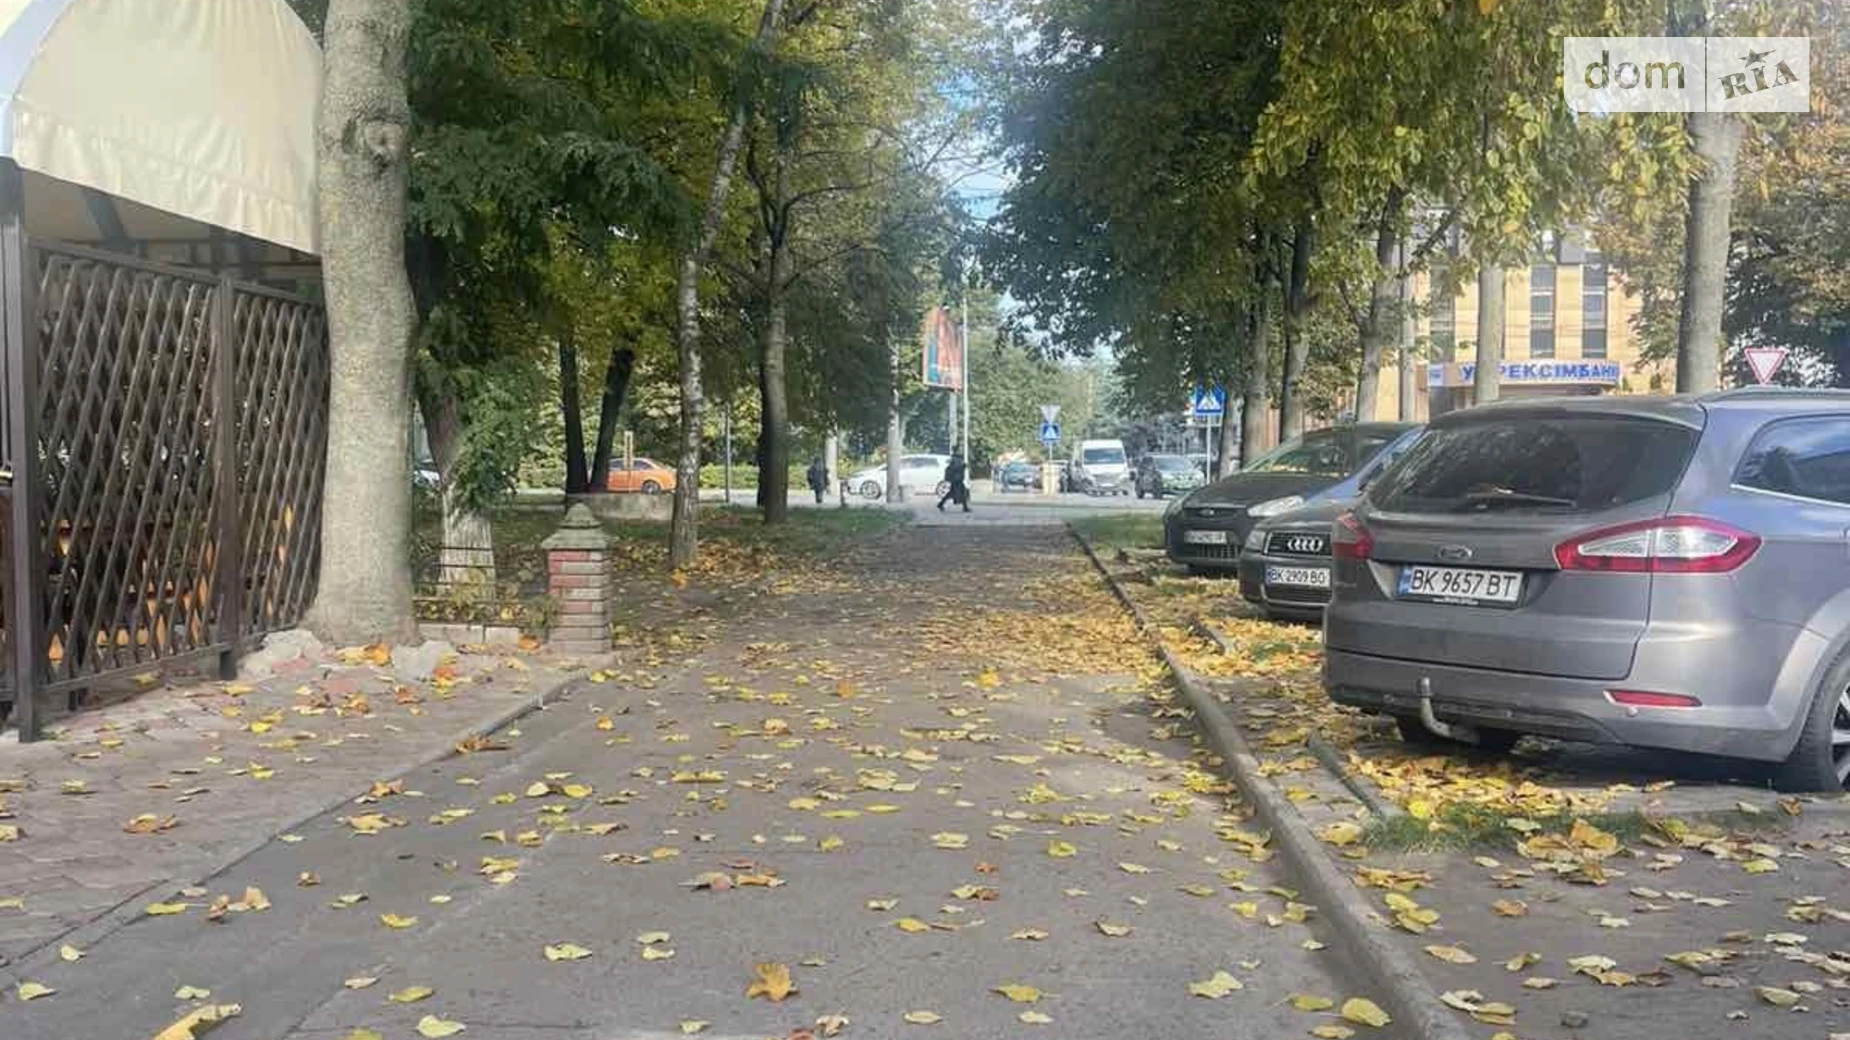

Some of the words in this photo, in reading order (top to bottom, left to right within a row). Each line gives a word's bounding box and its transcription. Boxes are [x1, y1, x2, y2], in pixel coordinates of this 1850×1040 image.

[1412, 569, 1438, 591] BK
[1441, 571, 1484, 595] 9657
[1487, 574, 1517, 596] BT
